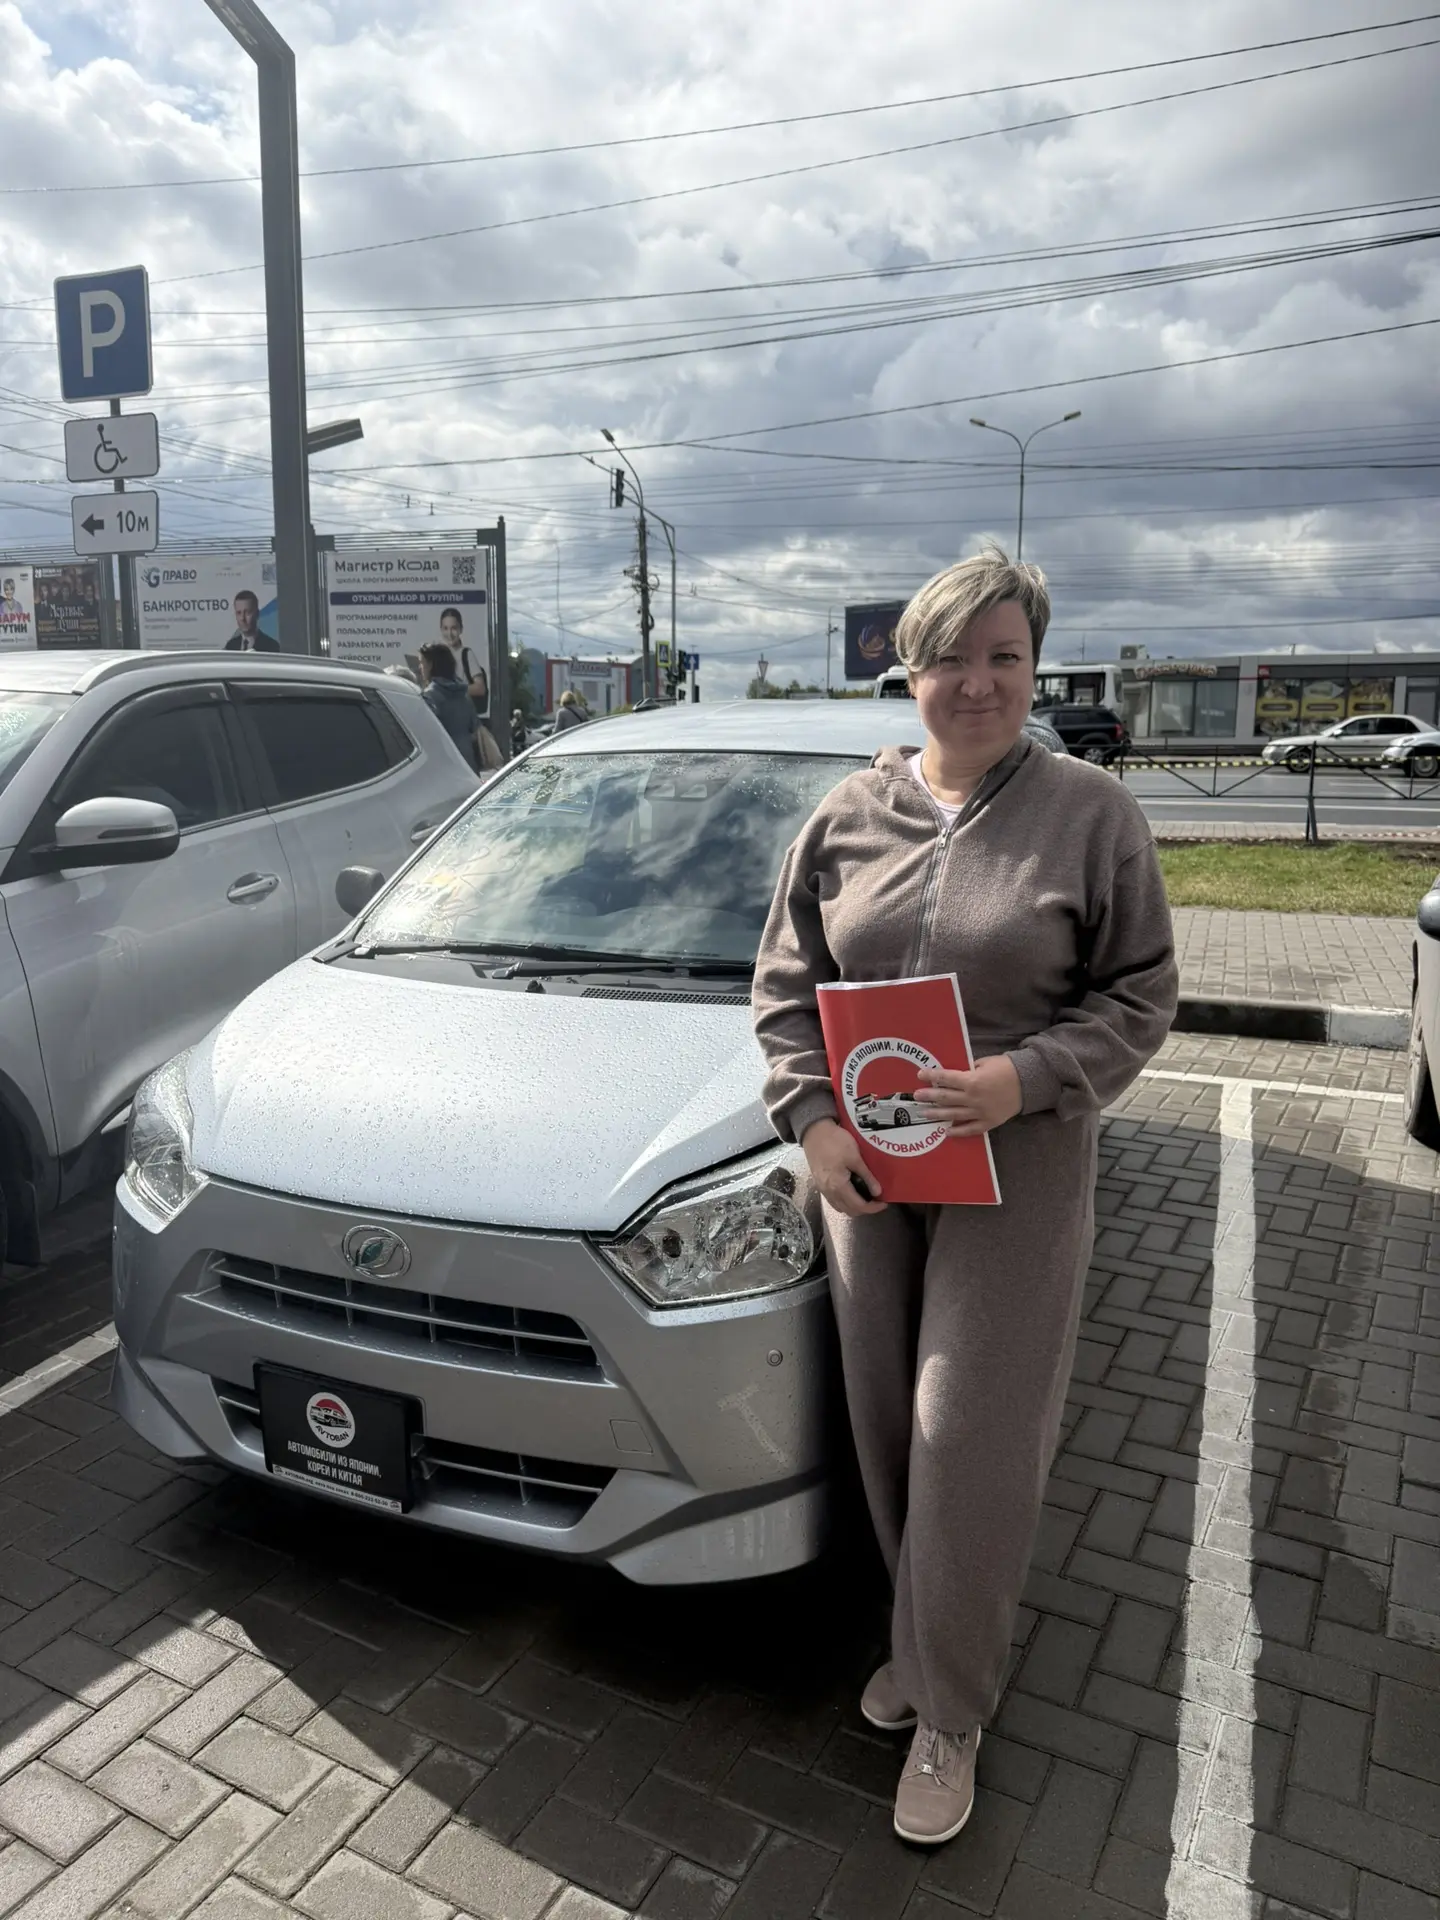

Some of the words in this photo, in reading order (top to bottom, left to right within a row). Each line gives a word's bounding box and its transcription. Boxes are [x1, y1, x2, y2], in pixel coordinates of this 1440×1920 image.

[79, 290, 126, 378] P
[334, 559, 394, 573] Магистр
[162, 569, 197, 581] ПРАВО
[363, 576, 438, 584] ПРОГРАММИРОВАНИЕ
[352, 594, 385, 603] ОТКРЫТ
[387, 594, 418, 602] НАБОР
[420, 594, 426, 602] В
[427, 593, 464, 602] ГРУППЫ
[143, 599, 229, 612] БАНКРОТСТВО
[0, 612, 31, 624] АРУМ
[336, 628, 395, 636] ПОЛЬЗОВАТЕЛЬ
[337, 641, 385, 649] РАЗРАБОТКА
[848, 1058, 859, 1072] ИЗ
[845, 1071, 855, 1097] АВТО
[869, 1126, 946, 1153] AVTOBAN.ORG
[315, 1425, 349, 1442] AVTOBAN
[287, 1440, 337, 1465] АВТОМОБИЛИ
[337, 1454, 348, 1468] ИЗ
[349, 1458, 382, 1479] ЯПОНИИ,
[307, 1459, 330, 1477] КОРЕИ
[331, 1467, 338, 1479] И
[338, 1469, 363, 1487] КИТАЯ
